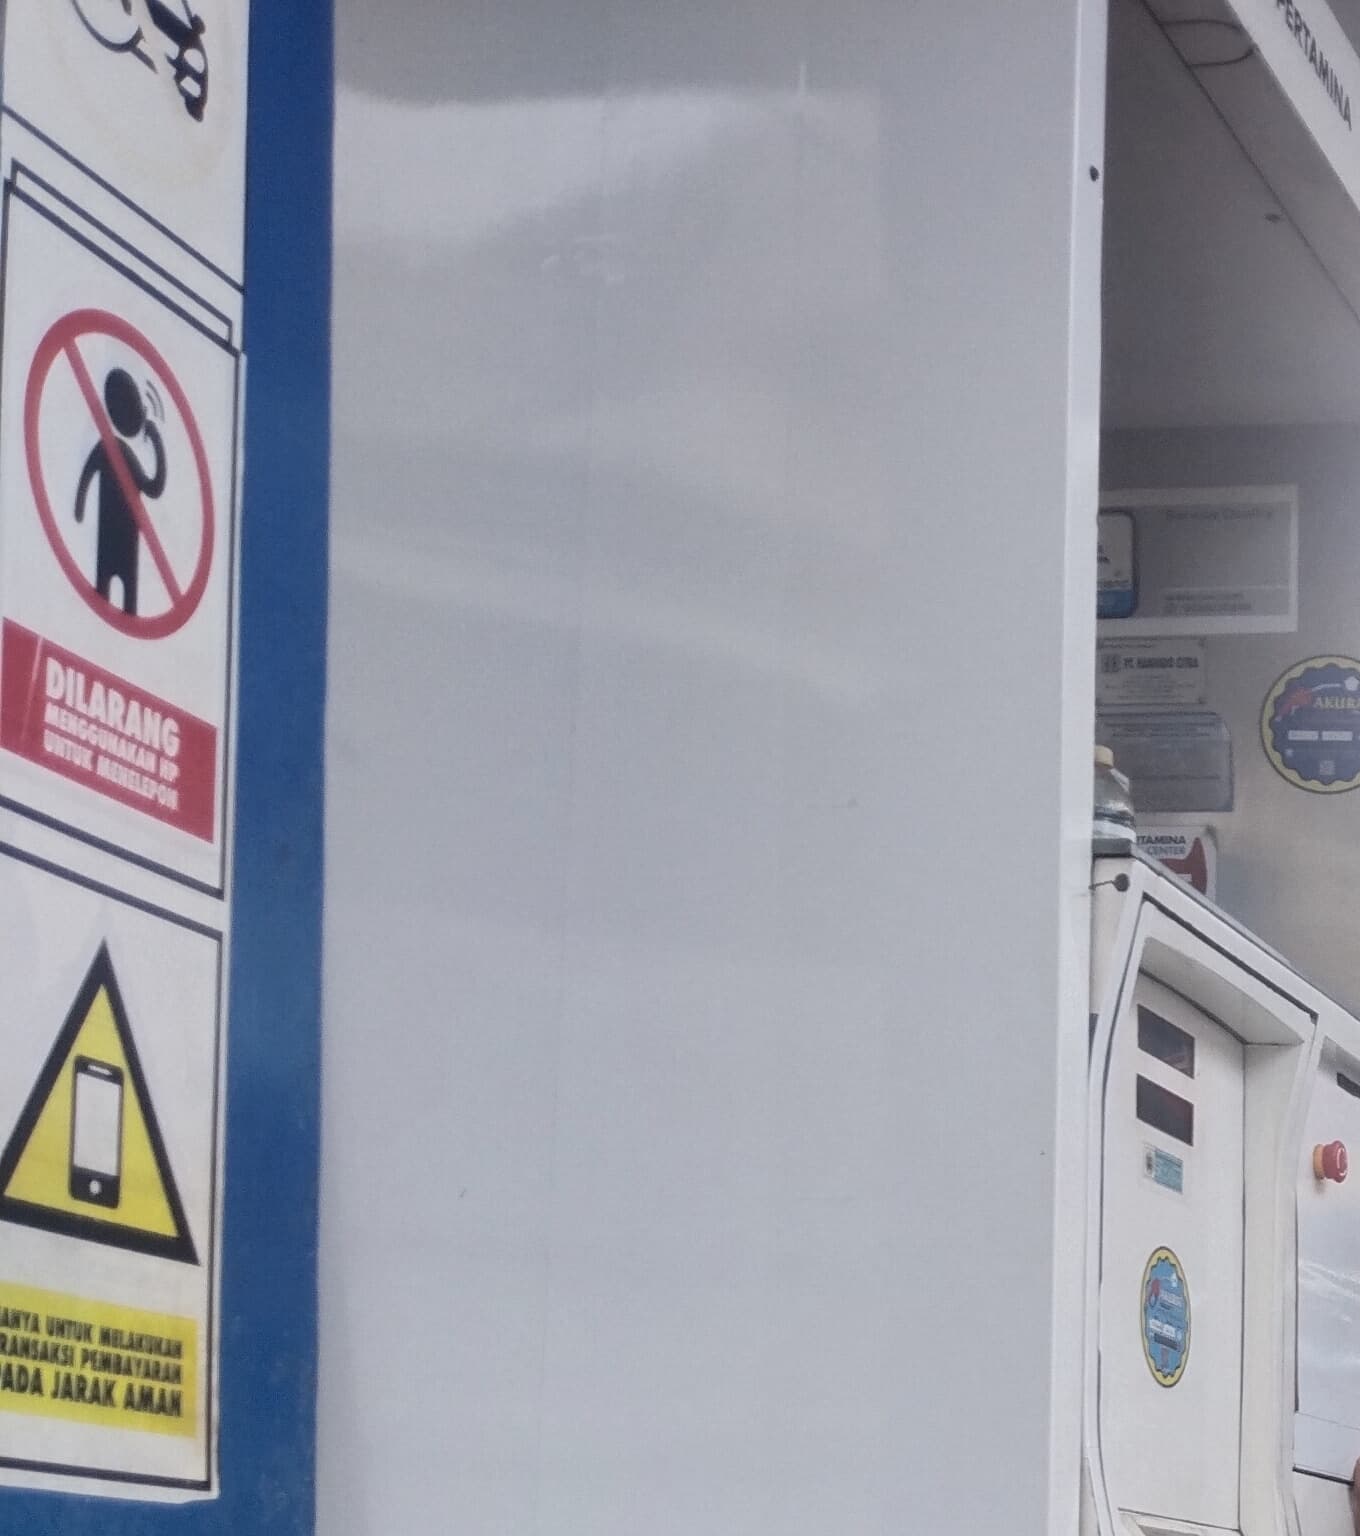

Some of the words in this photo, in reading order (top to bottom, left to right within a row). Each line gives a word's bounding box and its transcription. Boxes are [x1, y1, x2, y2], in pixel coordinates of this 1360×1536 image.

[46, 656, 180, 757] DILARANG
[44, 729, 94, 772] UNTUK
[45, 702, 157, 774] MENGGUNAKAN
[159, 757, 180, 782] HP
[46, 1315, 93, 1344] UNTUK
[0, 1361, 44, 1396] ADA
[52, 1370, 116, 1408] JARAK
[122, 1383, 182, 1418] AMAN
